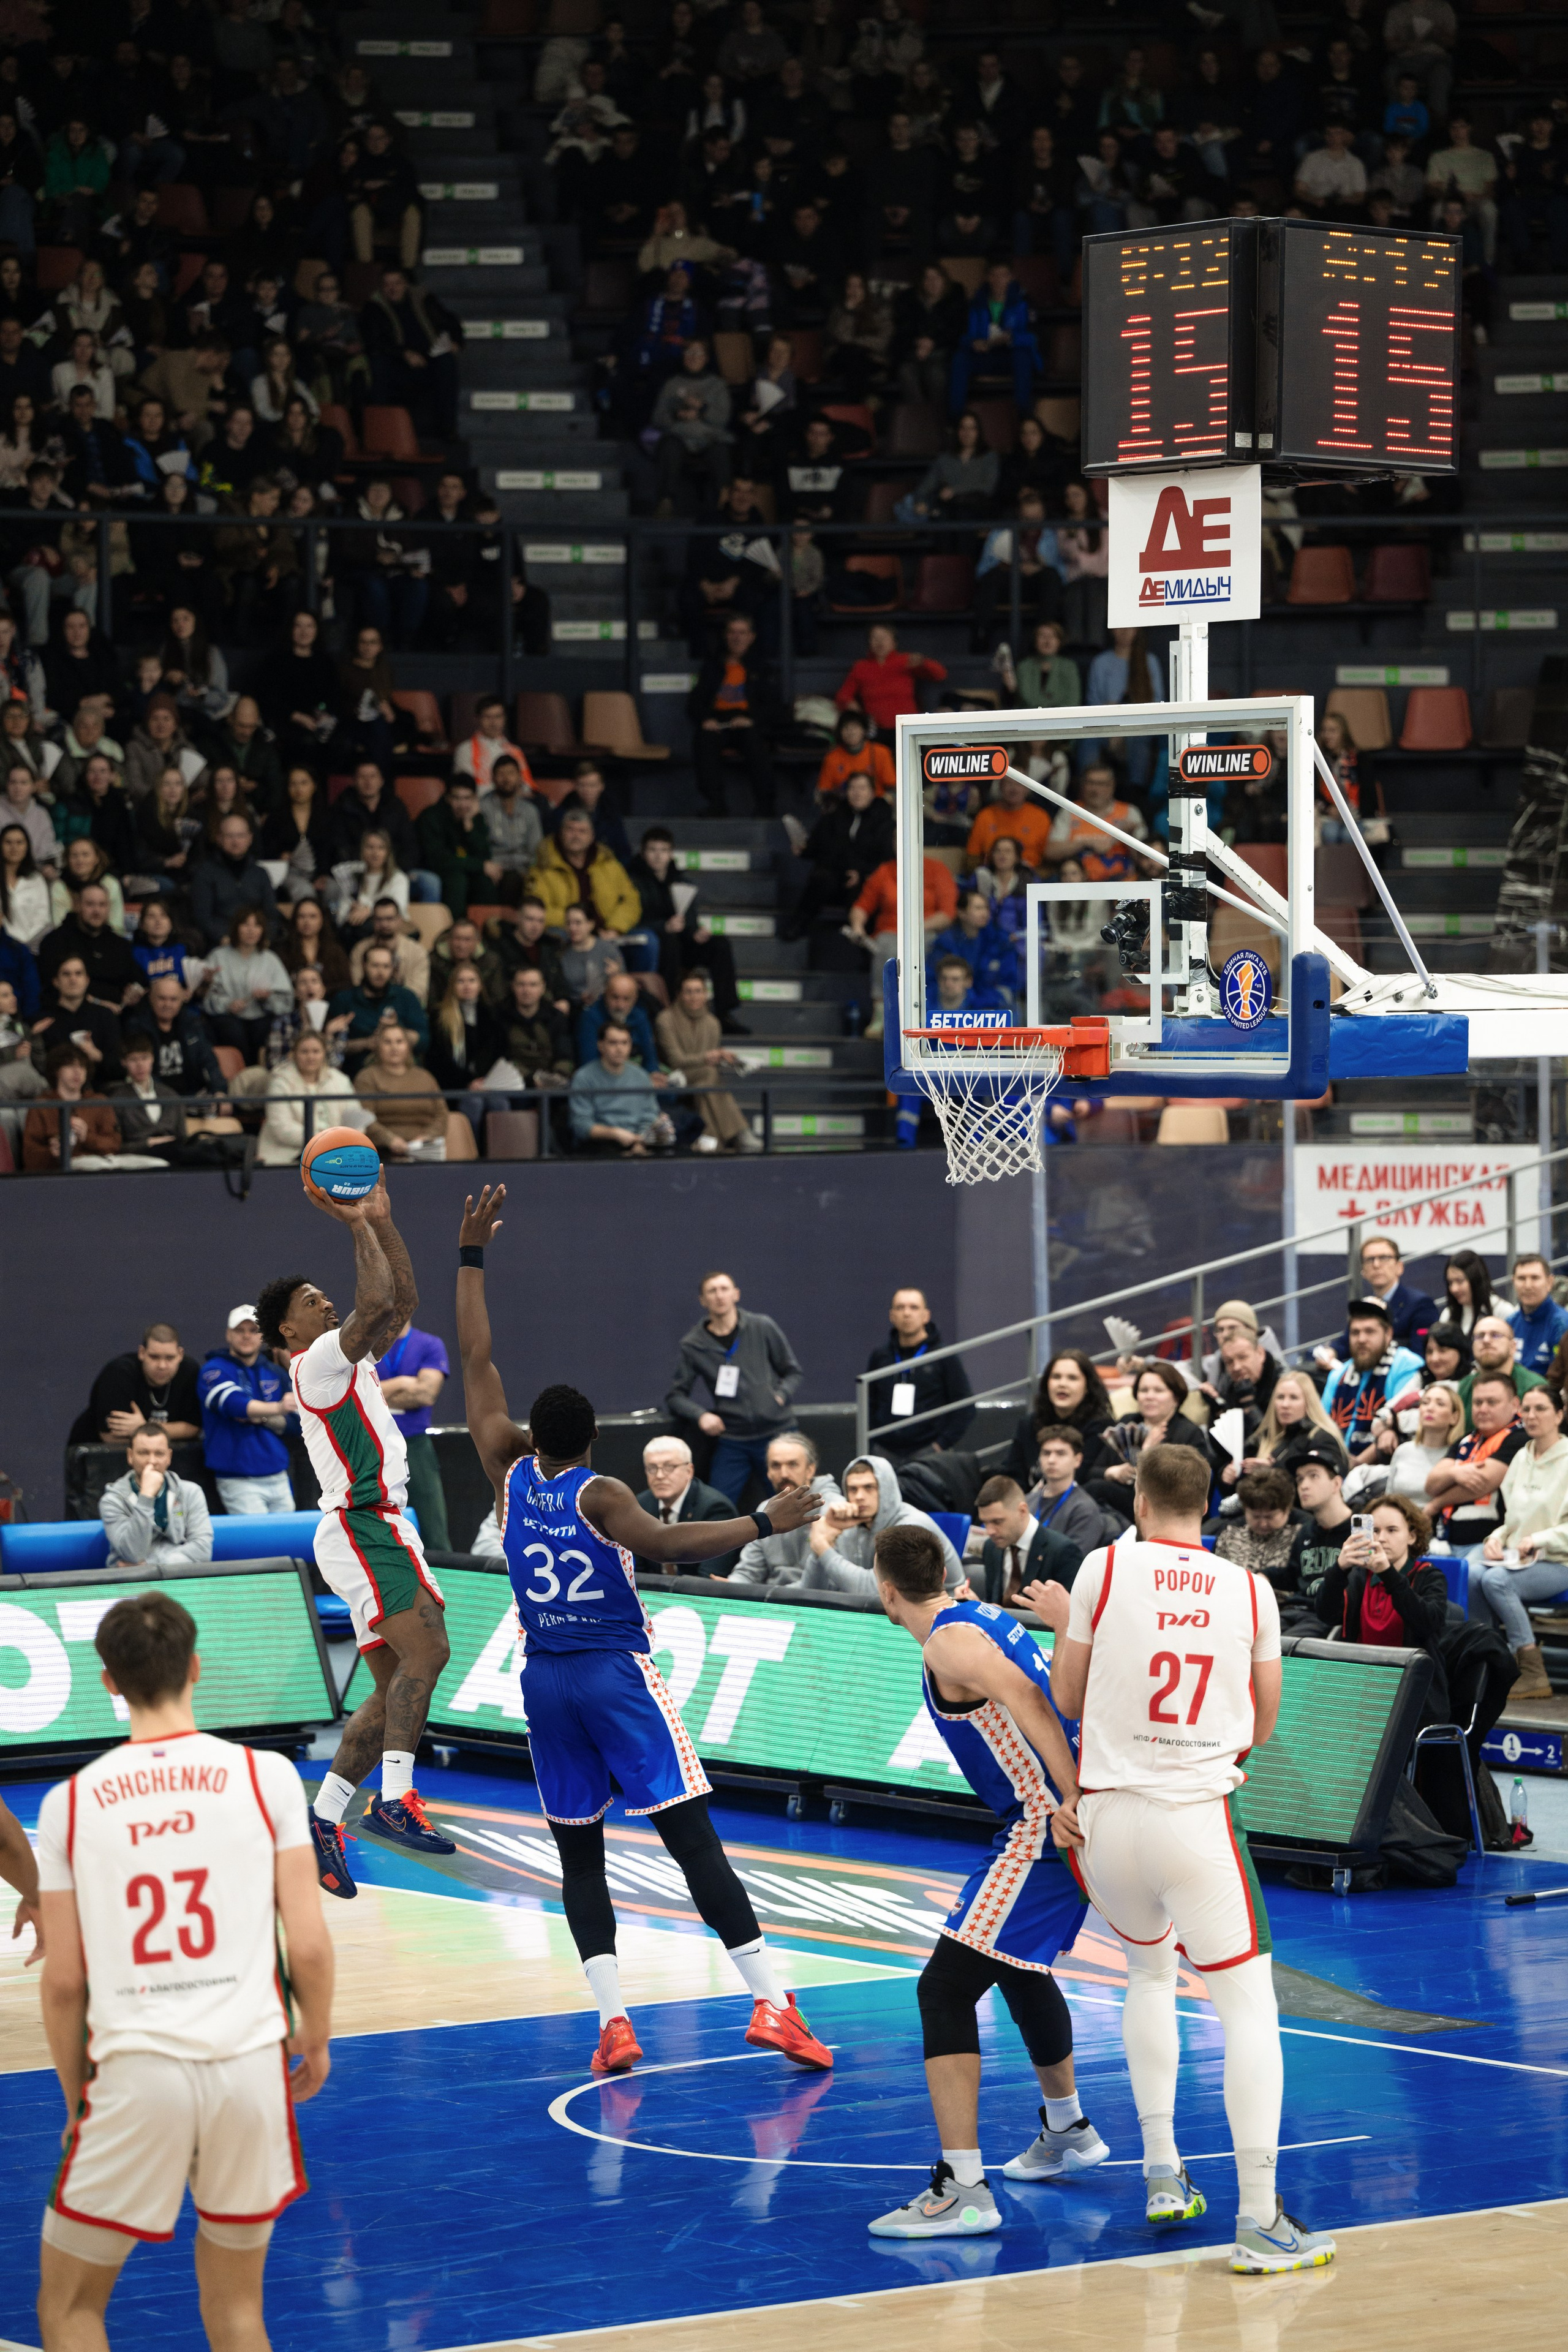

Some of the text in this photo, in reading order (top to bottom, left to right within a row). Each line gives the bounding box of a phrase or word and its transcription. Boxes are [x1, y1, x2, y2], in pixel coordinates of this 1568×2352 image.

[1117, 307, 1229, 461] 15
[1316, 302, 1455, 454] 15
[1139, 575, 1231, 601] ДЕМИДЫЧ
[931, 754, 990, 774] WINLINE
[1187, 753, 1251, 774] WINLINE
[1224, 952, 1268, 976] ЕДИНАЯ ЛИГА ВТБ
[930, 1013, 1007, 1028] БЕТСИТИ
[1223, 1004, 1268, 1029] VTB UNITED LEAGUE
[331, 1184, 372, 1196] SIBUR
[1376, 1200, 1487, 1226] СЛУЖБА
[522, 1543, 605, 1602] 32
[1155, 1569, 1216, 1596] POPOV
[1149, 1651, 1214, 1725] 27
[1158, 1737, 1221, 1747] БЛАГОСОСТОЯНИЕ
[1509, 1736, 1515, 1751] 1
[1547, 1744, 1556, 1760] 2
[92, 1764, 228, 1809] ISHCHENKO
[126, 1866, 217, 1966] 23
